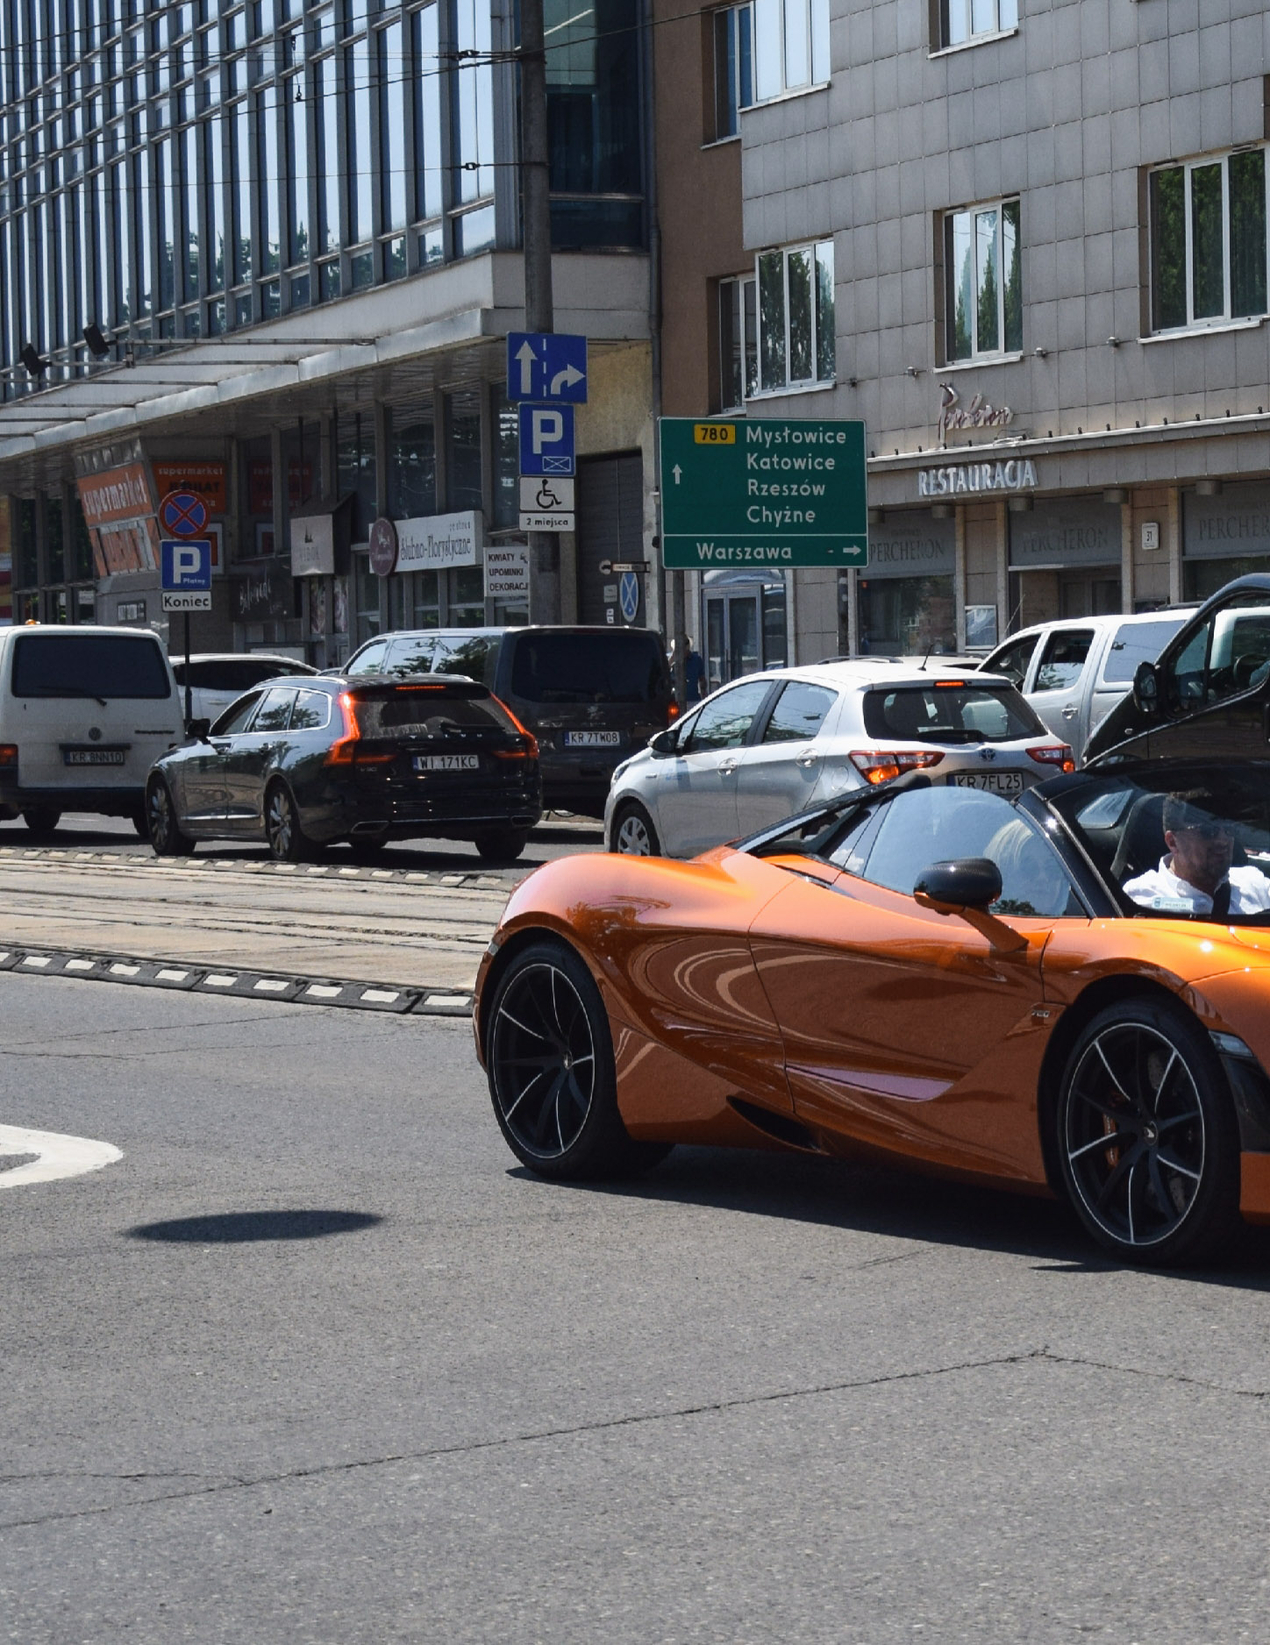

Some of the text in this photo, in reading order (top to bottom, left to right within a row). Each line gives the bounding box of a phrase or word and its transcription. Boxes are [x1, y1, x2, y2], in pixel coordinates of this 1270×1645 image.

[700, 425, 847, 449] 780 Mysłowice
[746, 452, 836, 470] Katowice
[158, 467, 223, 477] supermarket
[918, 459, 1039, 497] RESTAURACJA
[747, 478, 826, 496] Rzeszów
[83, 472, 148, 520] supermarket
[526, 517, 569, 529] 2 miejsca
[746, 505, 817, 529] Chyżne
[695, 542, 793, 561] Warszawa
[869, 537, 945, 563] PERCHERON
[488, 553, 515, 562] KWIATY
[489, 568, 524, 577] UPOMINKI
[490, 582, 529, 592] DEKORACJ
[164, 595, 209, 608] Koniec
[570, 732, 619, 744] KR 7TW08
[71, 752, 88, 763] KR
[420, 756, 476, 769] WI 171KC
[957, 774, 1021, 790] KR 7FL25
